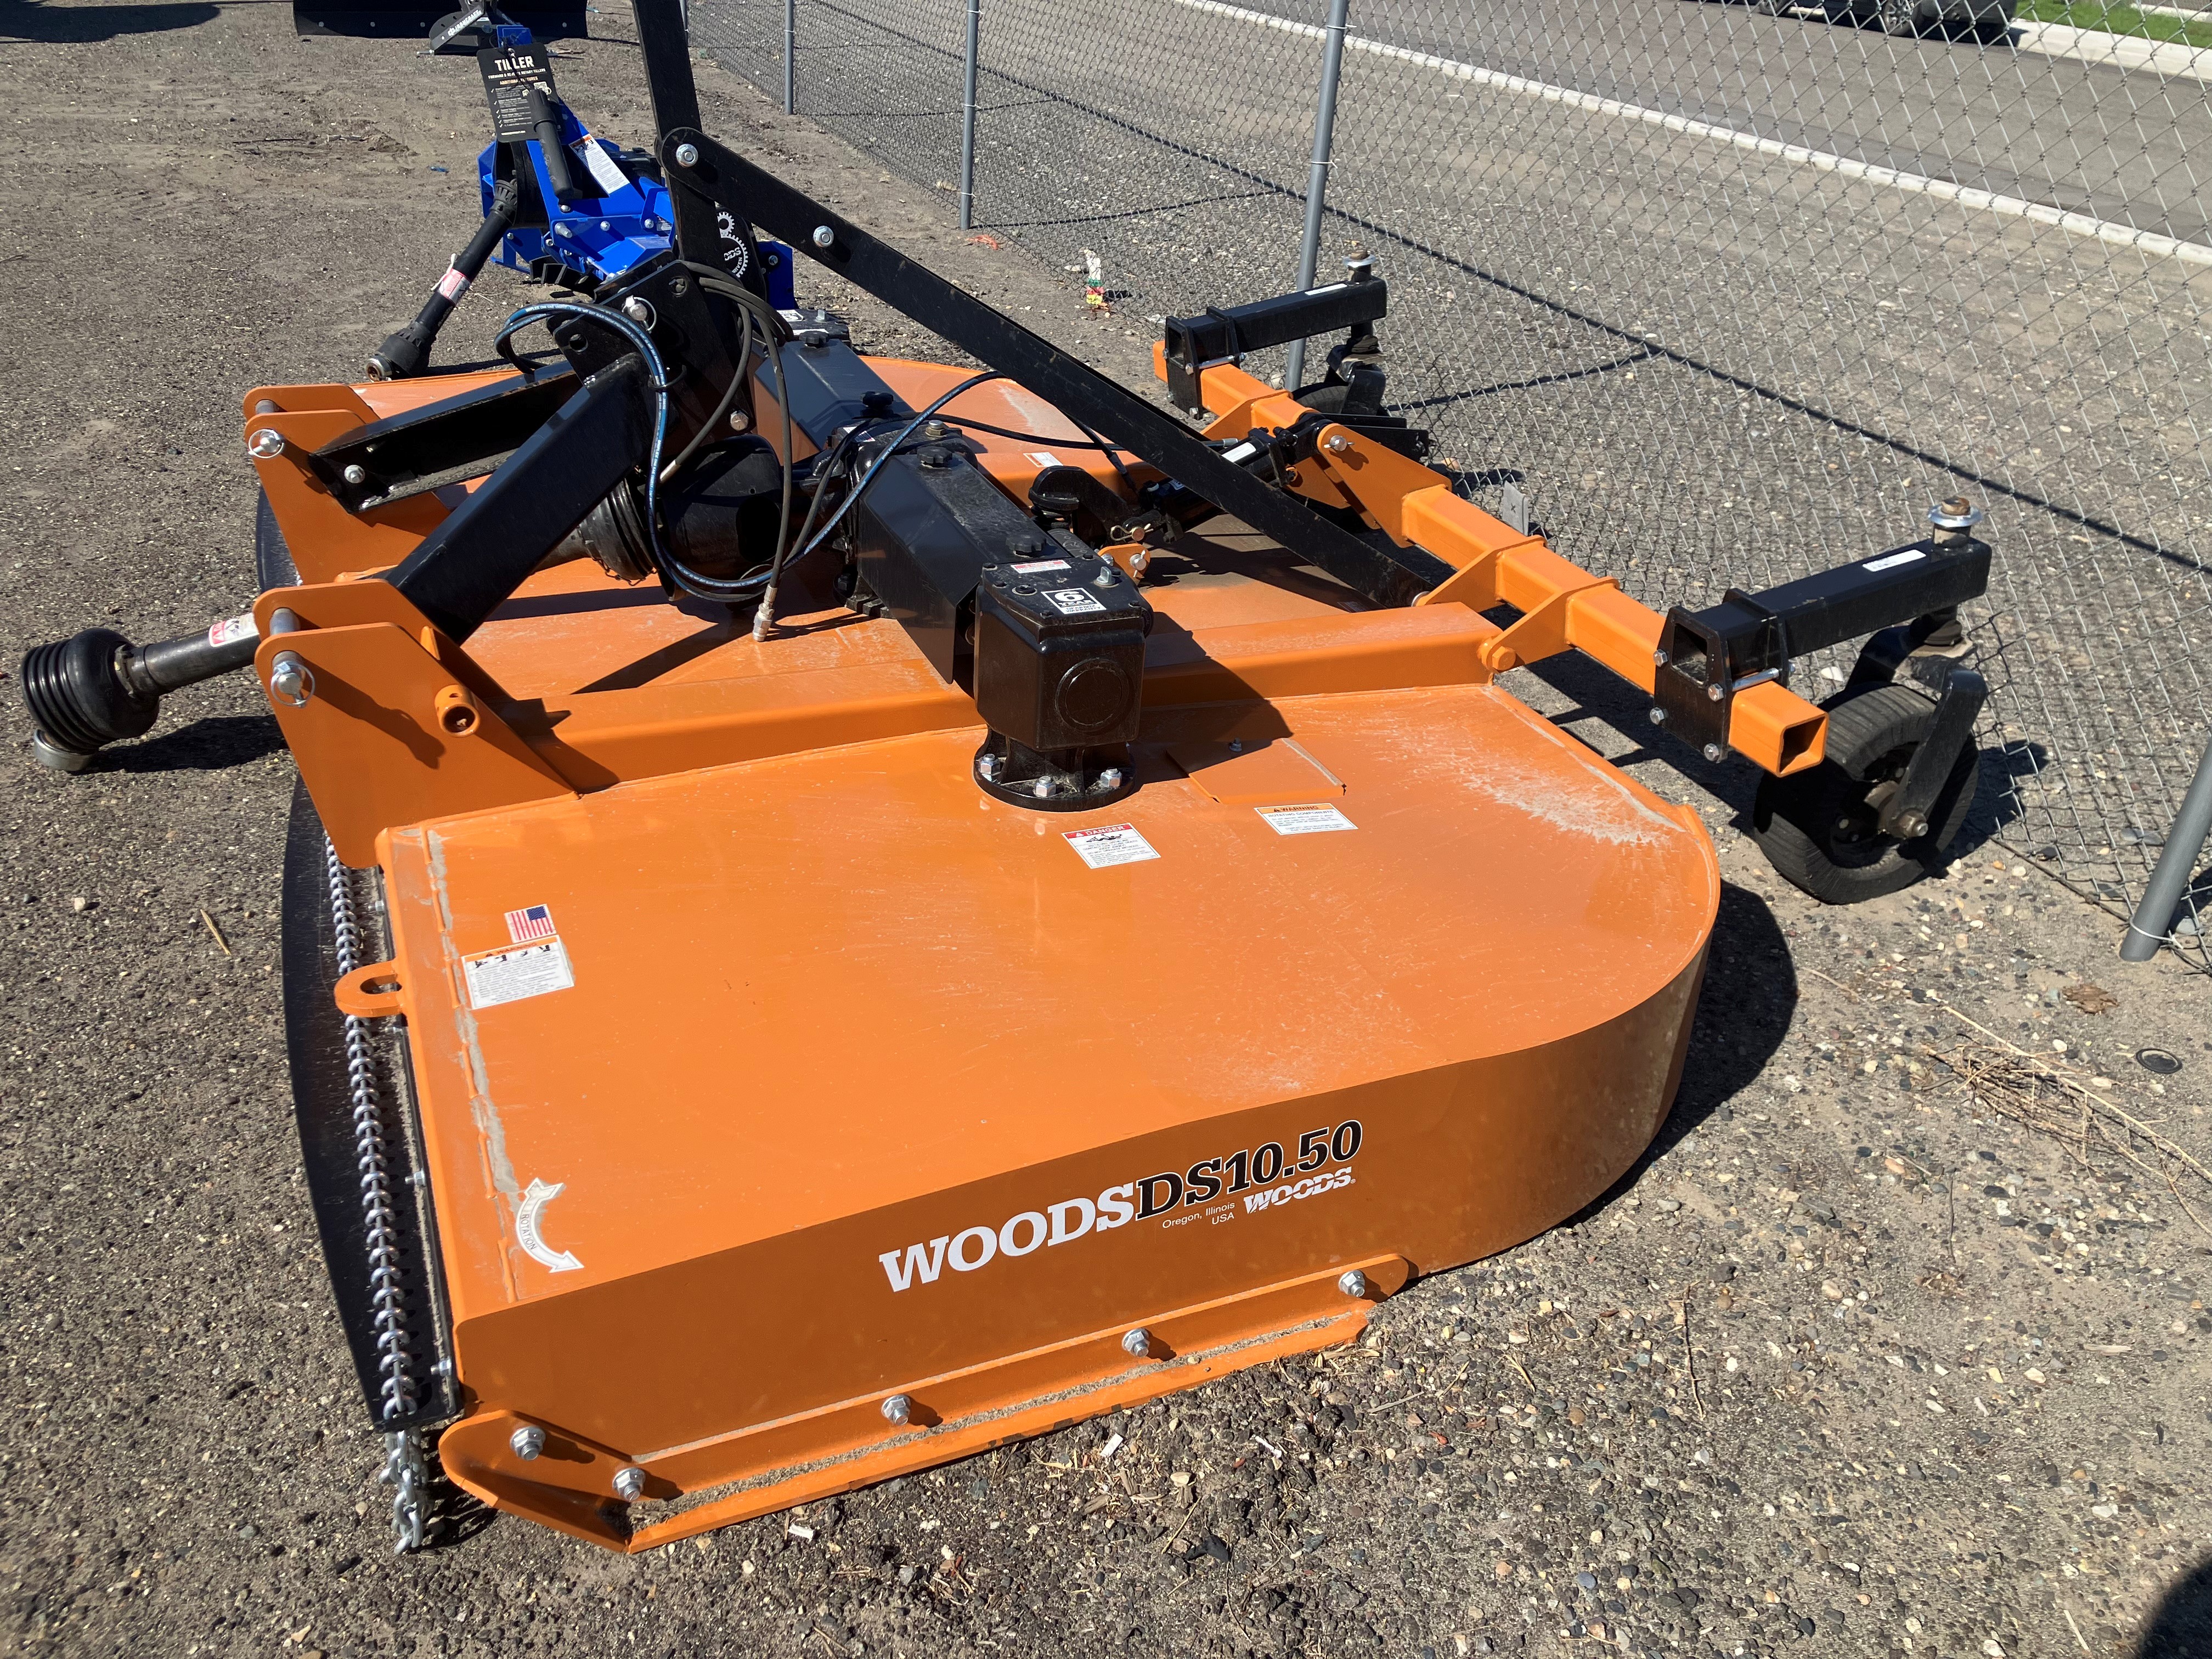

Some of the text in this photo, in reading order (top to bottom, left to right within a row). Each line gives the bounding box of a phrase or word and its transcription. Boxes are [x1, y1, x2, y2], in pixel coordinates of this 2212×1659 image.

[494, 55, 534, 71] TILLER
[1054, 591, 1085, 602] 6
[1086, 825, 1125, 836] DANGER
[1243, 1166, 1352, 1214] WOODS
[1162, 1201, 1235, 1228] Oregon, Illinois
[1211, 1211, 1234, 1224] USA
[520, 1214, 538, 1250] ROTATION
